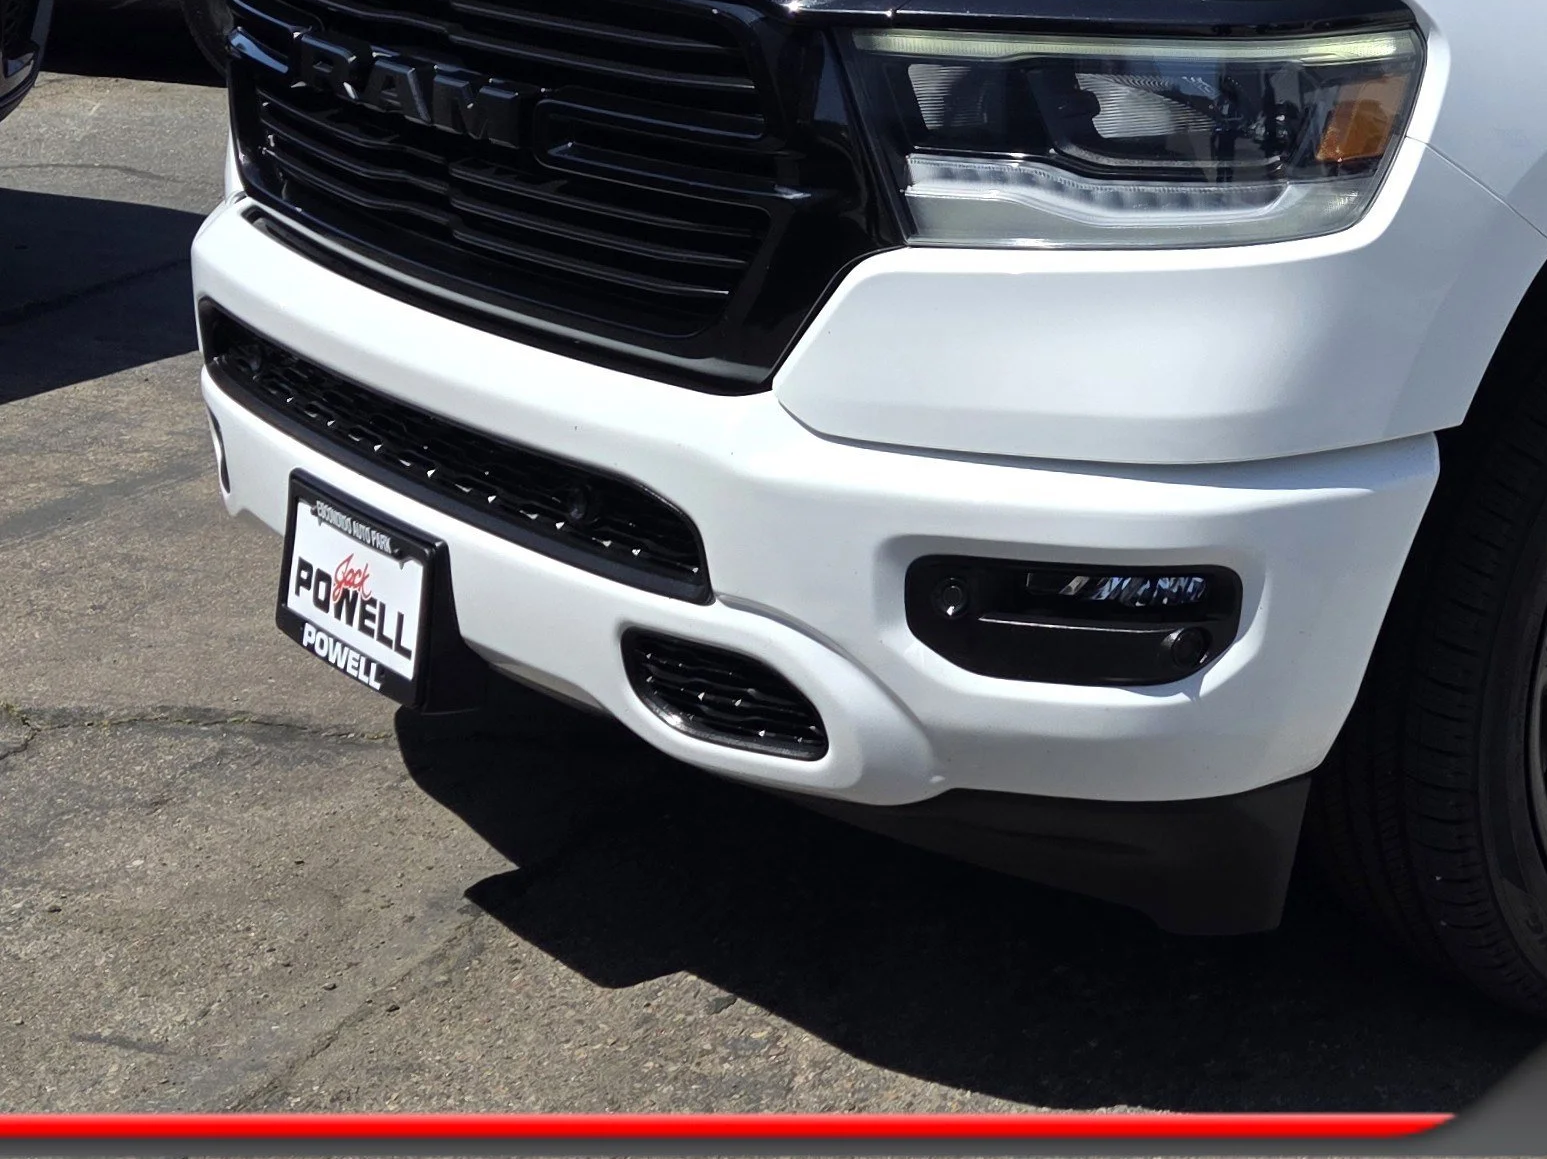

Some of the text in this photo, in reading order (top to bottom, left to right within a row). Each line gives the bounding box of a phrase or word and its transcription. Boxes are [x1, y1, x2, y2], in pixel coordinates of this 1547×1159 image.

[292, 31, 526, 149] RAM
[371, 530, 392, 554] PARK
[294, 556, 412, 660] POWELL
[332, 553, 372, 602] Jack
[302, 622, 382, 690] POWELL
